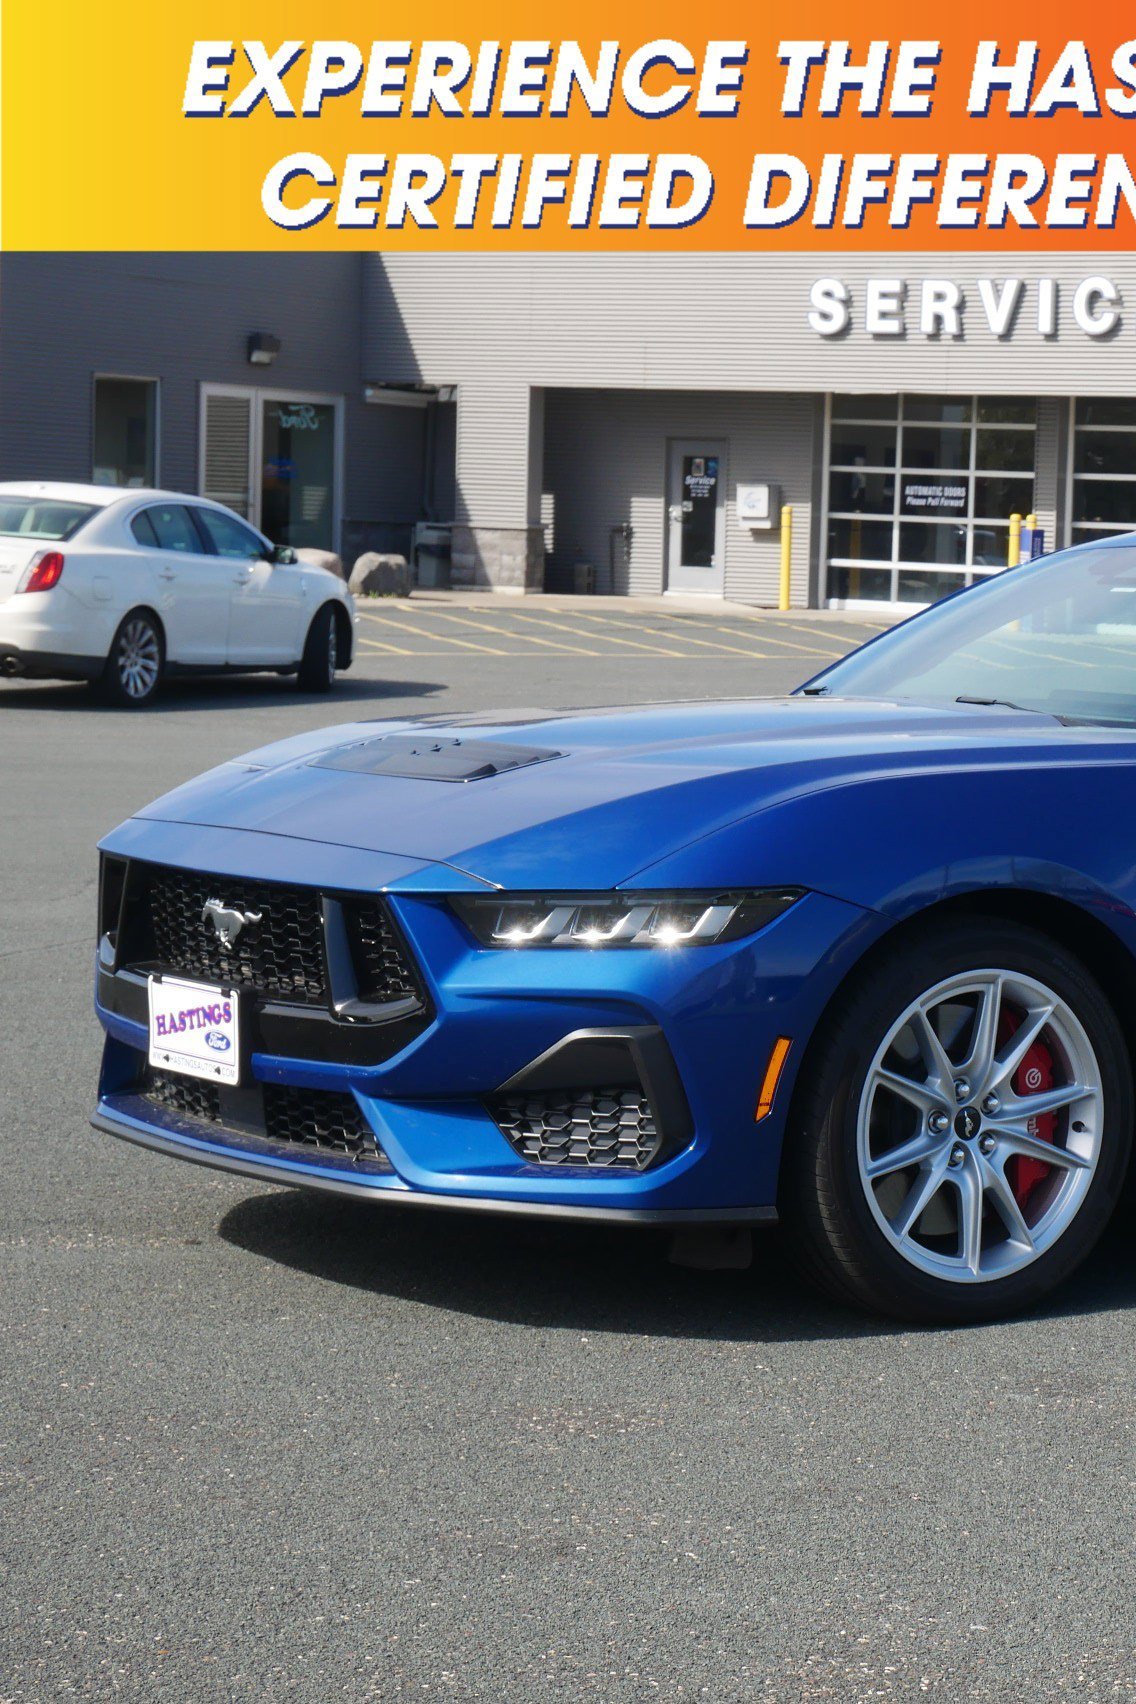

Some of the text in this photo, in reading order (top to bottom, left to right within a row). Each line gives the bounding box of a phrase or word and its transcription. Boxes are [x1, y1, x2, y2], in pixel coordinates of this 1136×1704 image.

[685, 475, 716, 485] Service
[905, 485, 966, 497] AUTOMATIC DOORS
[155, 1001, 232, 1036] HASTINGS
